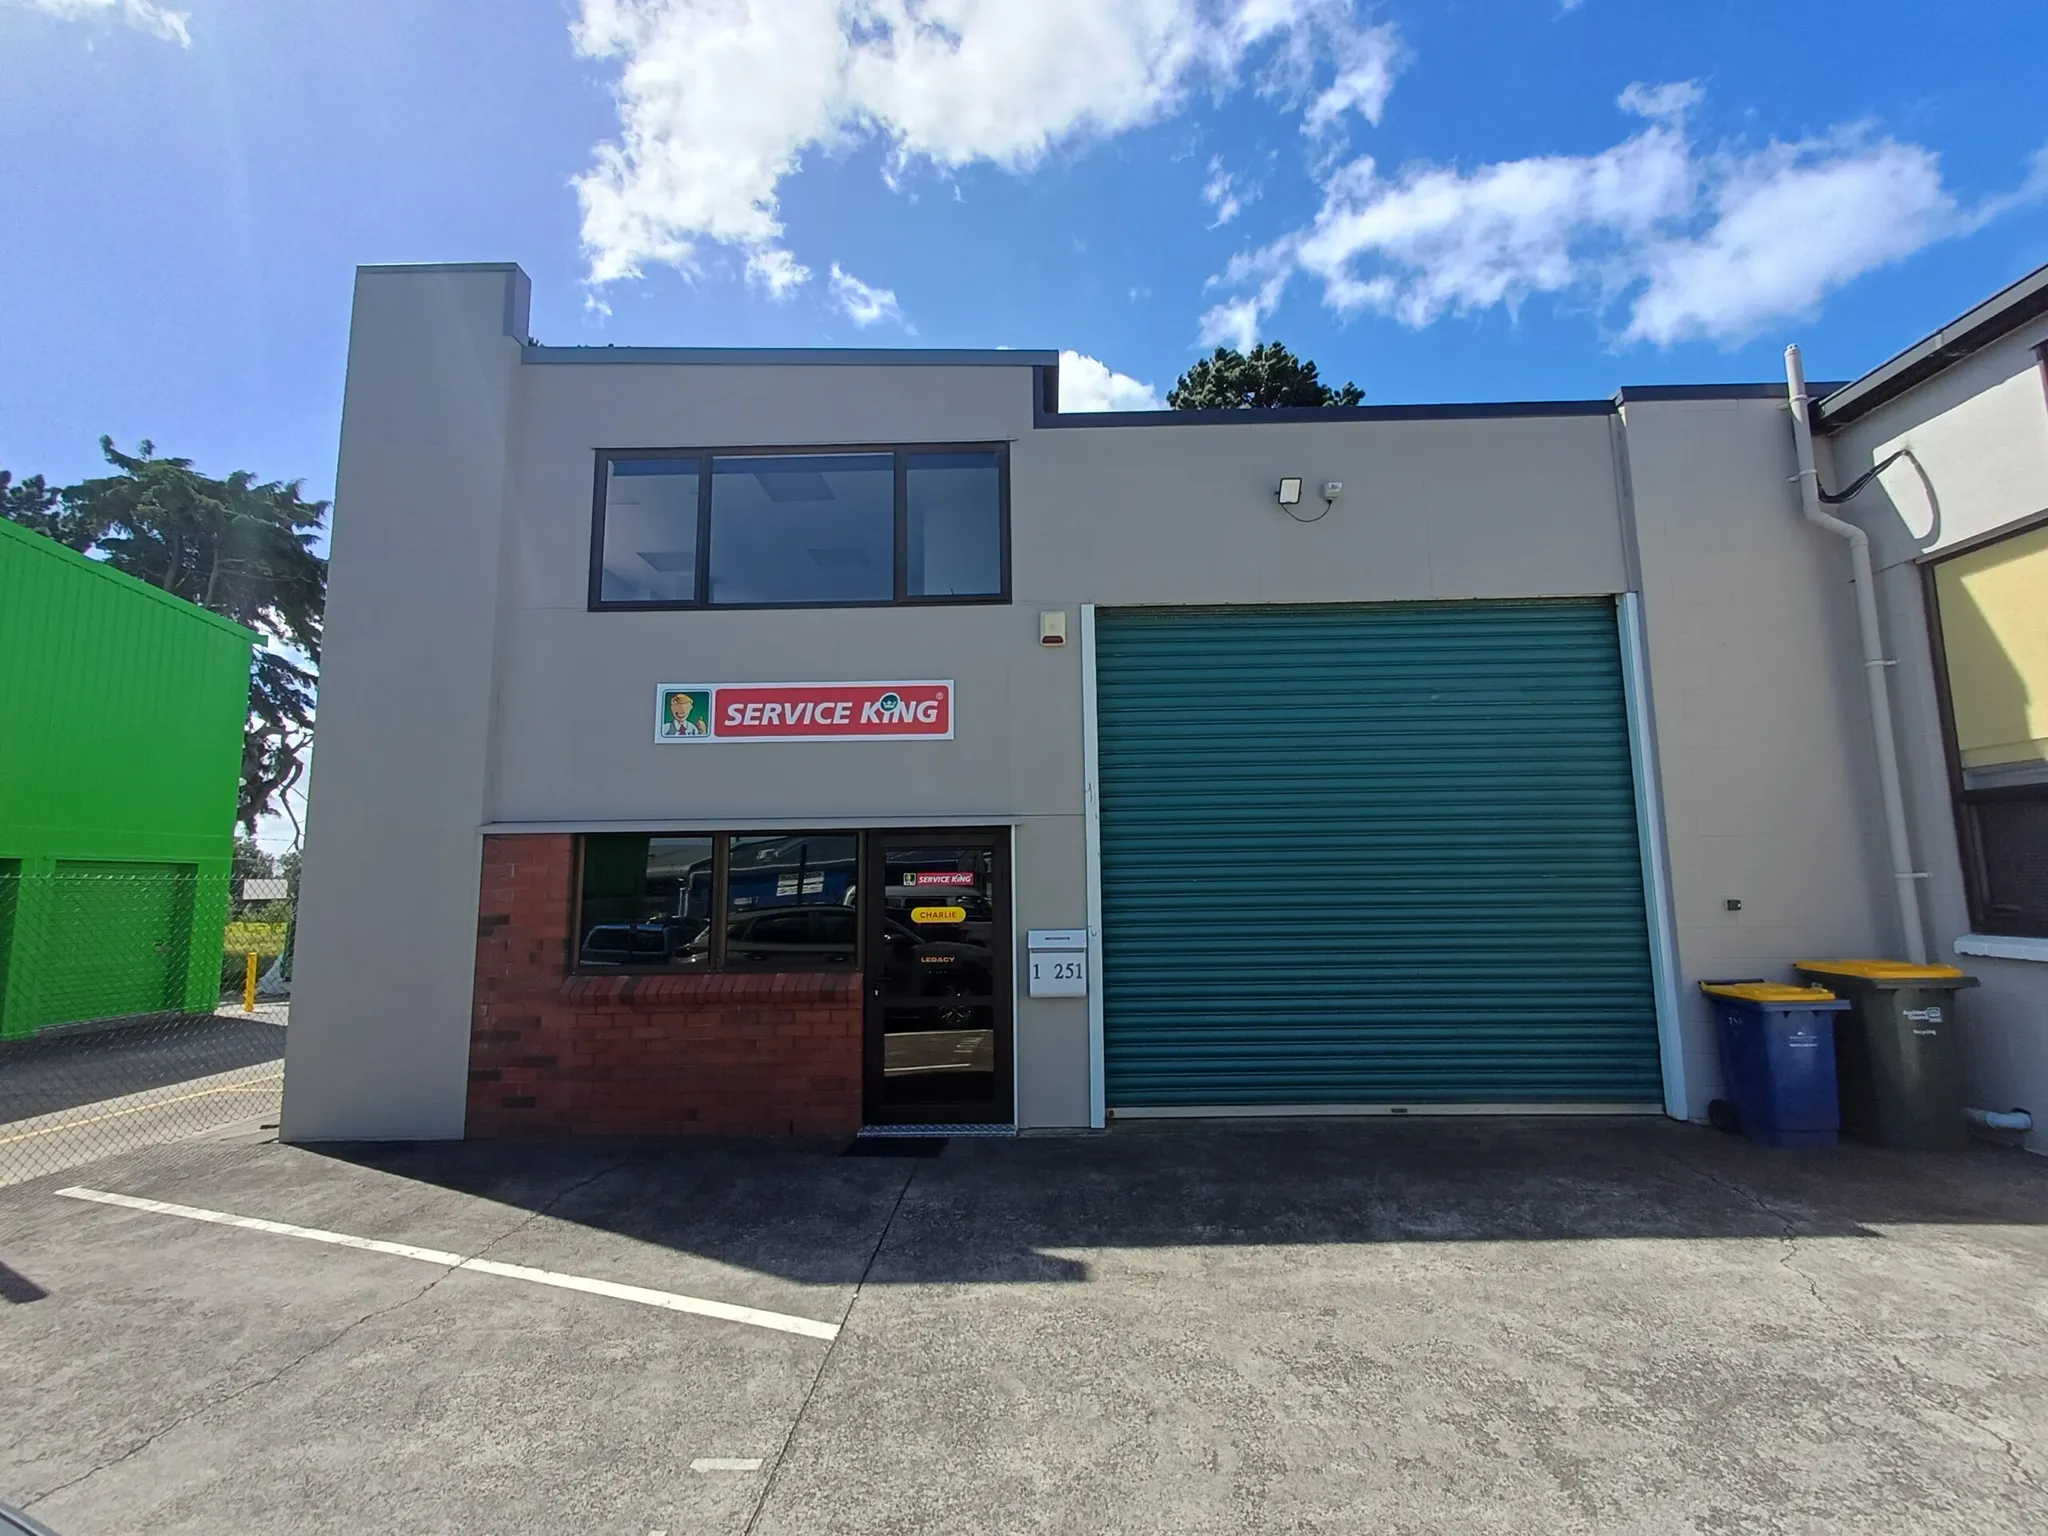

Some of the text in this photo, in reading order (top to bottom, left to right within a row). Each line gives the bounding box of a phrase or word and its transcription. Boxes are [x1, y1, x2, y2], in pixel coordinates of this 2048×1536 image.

[724, 692, 938, 726] SERVICE KING
[918, 874, 971, 884] SERVICE KING
[920, 911, 957, 919] CHARLIE
[1033, 963, 1083, 979] 1 251
